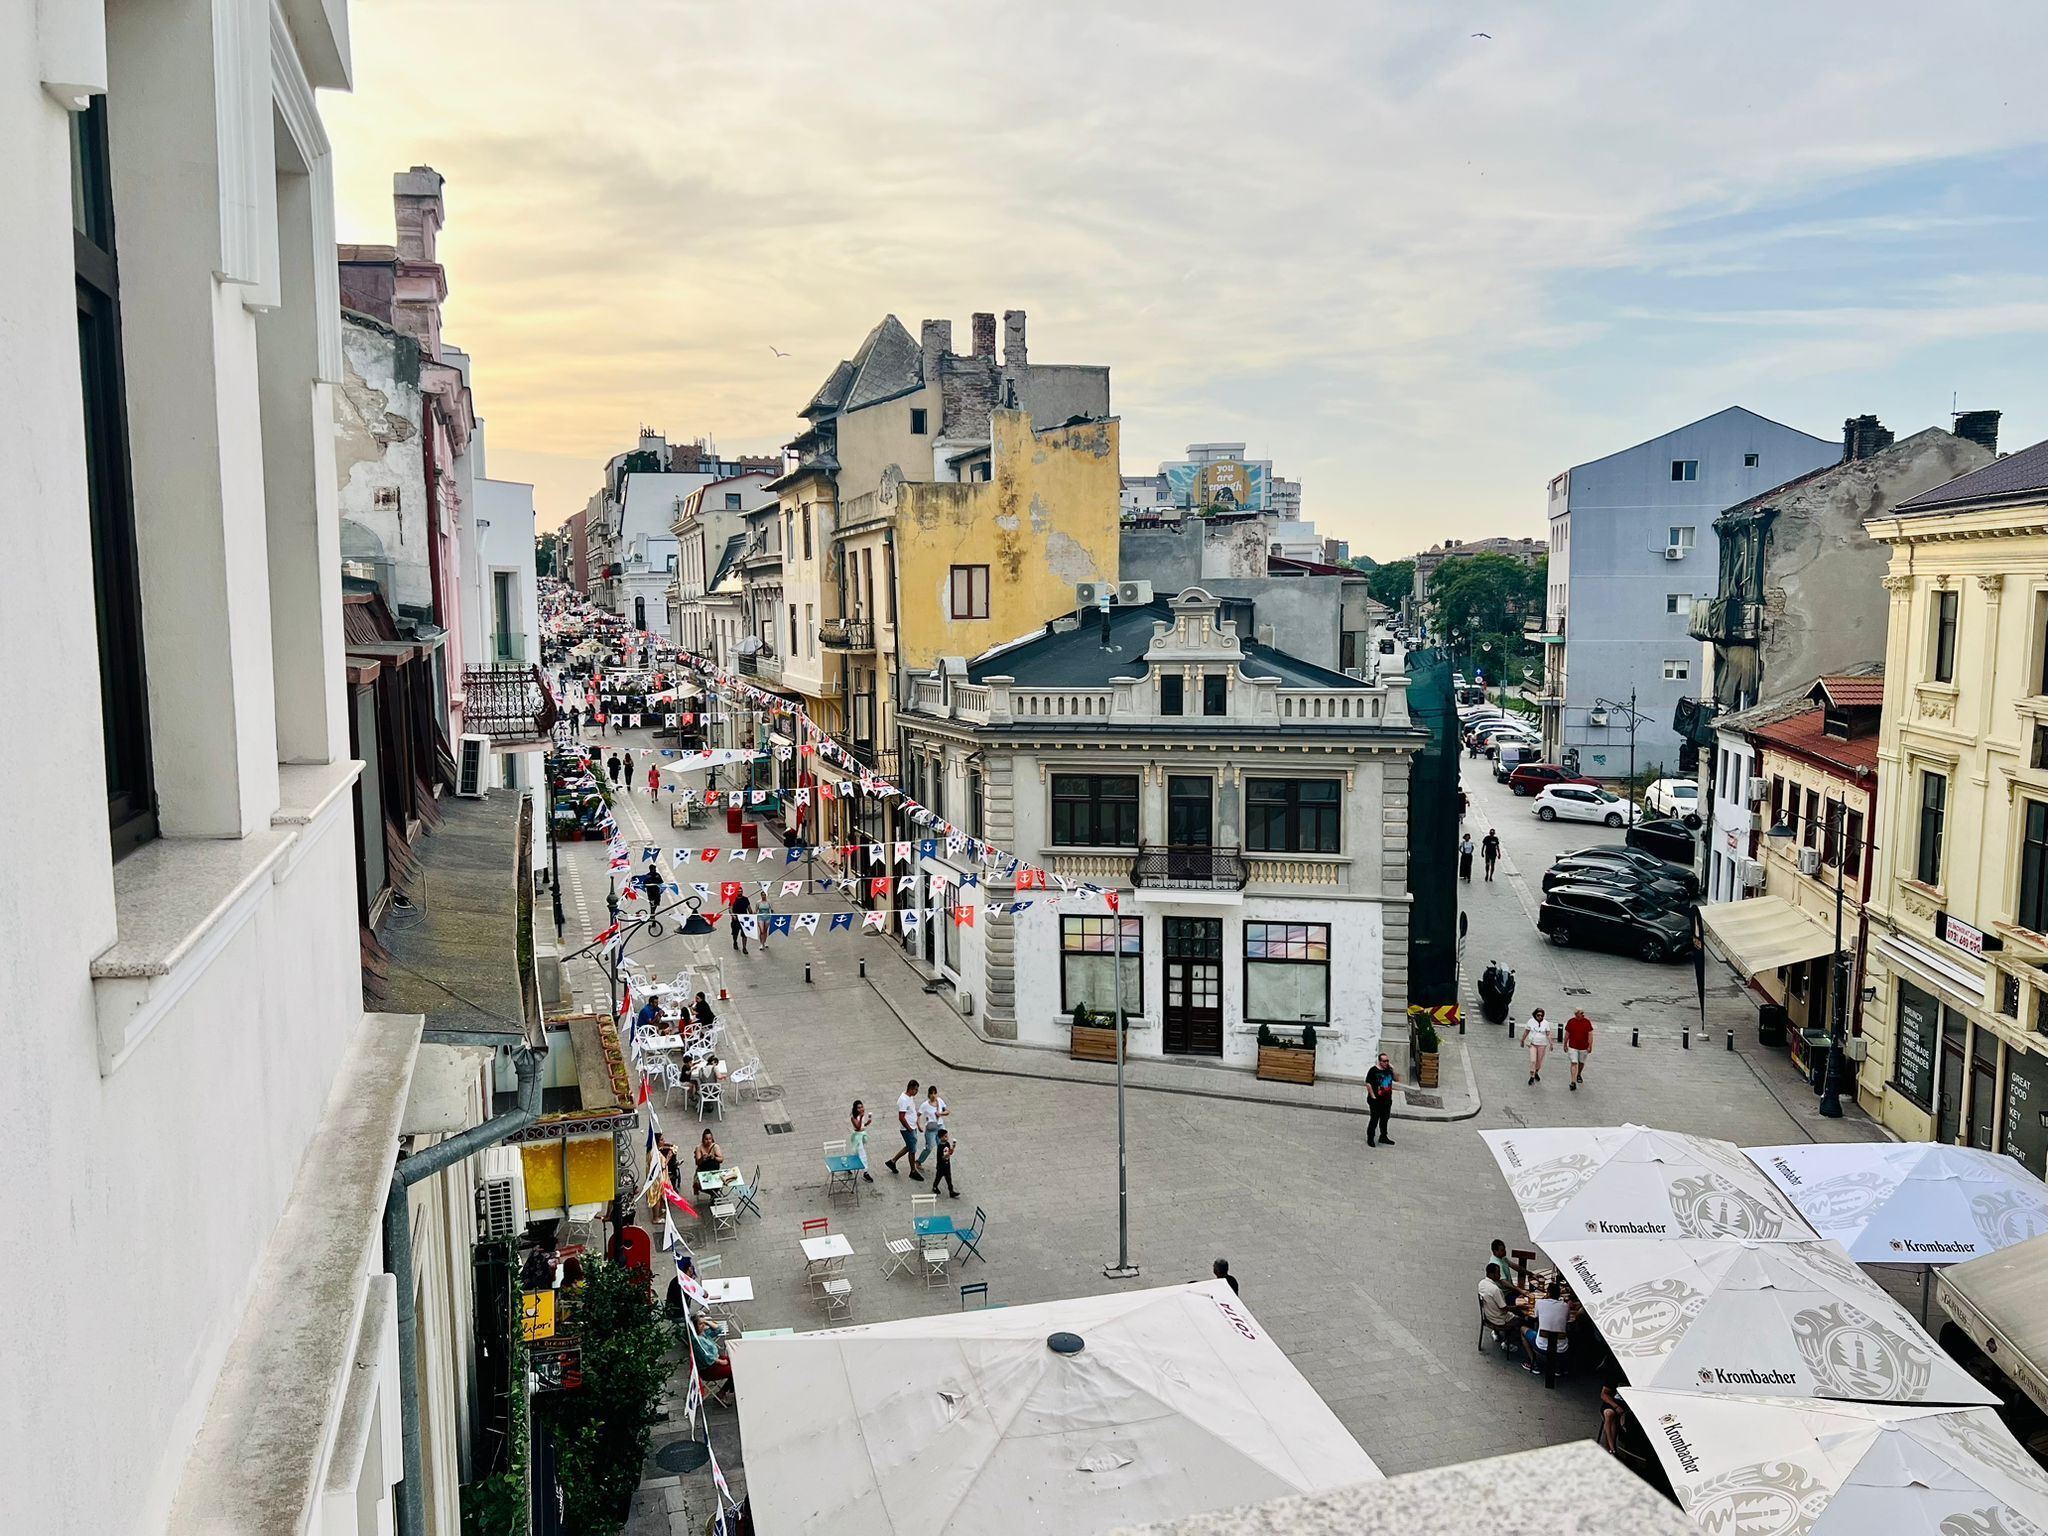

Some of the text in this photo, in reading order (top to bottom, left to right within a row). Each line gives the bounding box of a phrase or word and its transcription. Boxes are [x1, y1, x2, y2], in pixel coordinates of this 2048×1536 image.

[1217, 465, 1233, 475] you
[1905, 1005, 1923, 1022] BRUNCH
[1904, 1016, 1919, 1031] LUNCH
[1903, 1026, 1920, 1042] DINNER
[1903, 1036, 1929, 1060] HOME-MADE
[1902, 1046, 1929, 1070] LEMONADES
[1902, 1056, 1918, 1073] COFFEE
[2011, 1072, 2031, 1091] GREAT
[2009, 1095, 2016, 1106] IS
[2010, 1083, 2027, 1101] FOOD
[2009, 1107, 2021, 1121] KEY
[2009, 1118, 2017, 1130] TO
[2007, 1131, 2012, 1140] A
[2007, 1142, 2026, 1161] GREAT
[1600, 1221, 1666, 1234] Krombacher
[1904, 1240, 1976, 1253] Krombacher
[1573, 1260, 1603, 1295] Krombacher
[1220, 1303, 1255, 1340] COSTA
[1715, 1368, 1797, 1385] Krombacher
[1663, 1422, 1700, 1474] Krombacher
